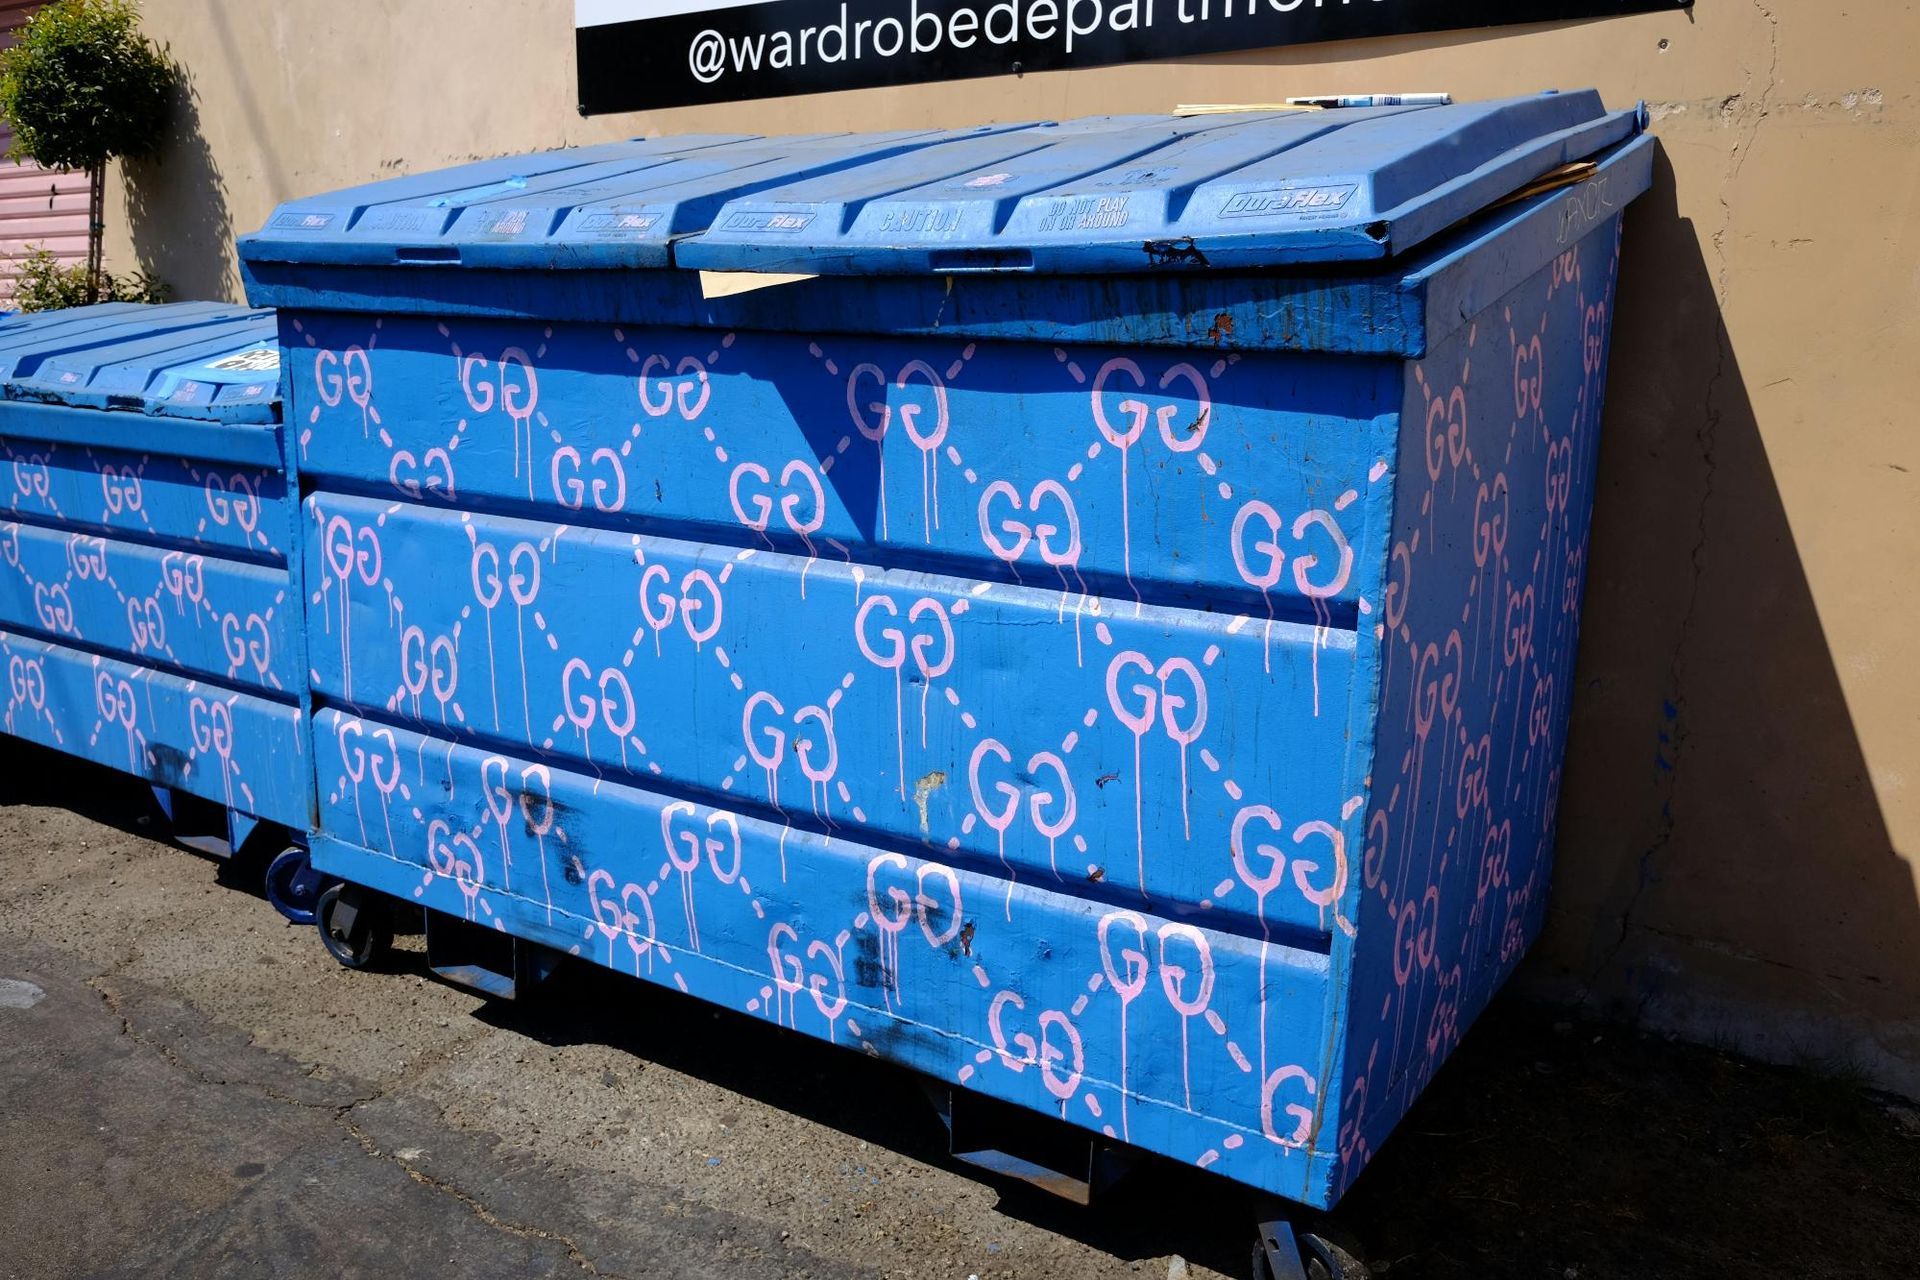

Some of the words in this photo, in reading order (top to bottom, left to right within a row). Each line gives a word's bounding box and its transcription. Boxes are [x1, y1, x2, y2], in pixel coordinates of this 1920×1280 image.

[689, 0, 1387, 83] @wardrobedepart
[878, 208, 964, 232] CAUTION
[1069, 199, 1096, 215] NOT
[1096, 196, 1130, 214] PLAY
[1076, 209, 1130, 230] AROUND
[315, 345, 372, 406] GG
[463, 346, 538, 418] GG
[639, 354, 710, 420] GG
[847, 360, 949, 450] GG
[1091, 357, 1211, 452] GG
[1514, 335, 1543, 418] GG
[1426, 385, 1467, 481] GG
[13, 453, 49, 497] GG
[101, 464, 142, 515] GG
[205, 471, 258, 533] GG
[390, 448, 457, 502] GG
[552, 446, 626, 513] GG
[729, 460, 825, 533] GG
[1545, 436, 1572, 512] GG
[70, 532, 107, 582] GG
[326, 515, 382, 587] GG
[978, 480, 1081, 566] GG
[1231, 500, 1354, 599] GG
[1474, 472, 1509, 567] GG
[34, 581, 73, 632] GG
[162, 550, 203, 604] GG
[471, 541, 540, 609] GG
[640, 564, 723, 642] GG
[128, 596, 165, 649] GG
[222, 612, 270, 675] GG
[855, 595, 955, 677] GG
[1504, 584, 1534, 667] GG
[10, 654, 45, 710] GG
[98, 671, 136, 731] GG
[402, 625, 458, 702] GG
[562, 657, 636, 738] GG
[1106, 650, 1208, 745] GG
[1415, 628, 1463, 736] GG
[190, 697, 233, 758] GG
[339, 720, 400, 793] GG
[742, 691, 838, 782] GG
[481, 755, 554, 835] GG
[968, 738, 1077, 838] GG
[1457, 735, 1490, 818] GG
[428, 819, 483, 897] GG
[661, 801, 742, 884] GG
[1231, 804, 1349, 907] GG
[1478, 819, 1512, 896] GG
[588, 869, 656, 954] GG
[867, 853, 962, 947] GG
[1394, 885, 1439, 986] GG
[767, 922, 848, 1020] GG
[1098, 911, 1215, 1016] GG
[988, 990, 1084, 1098] GG
